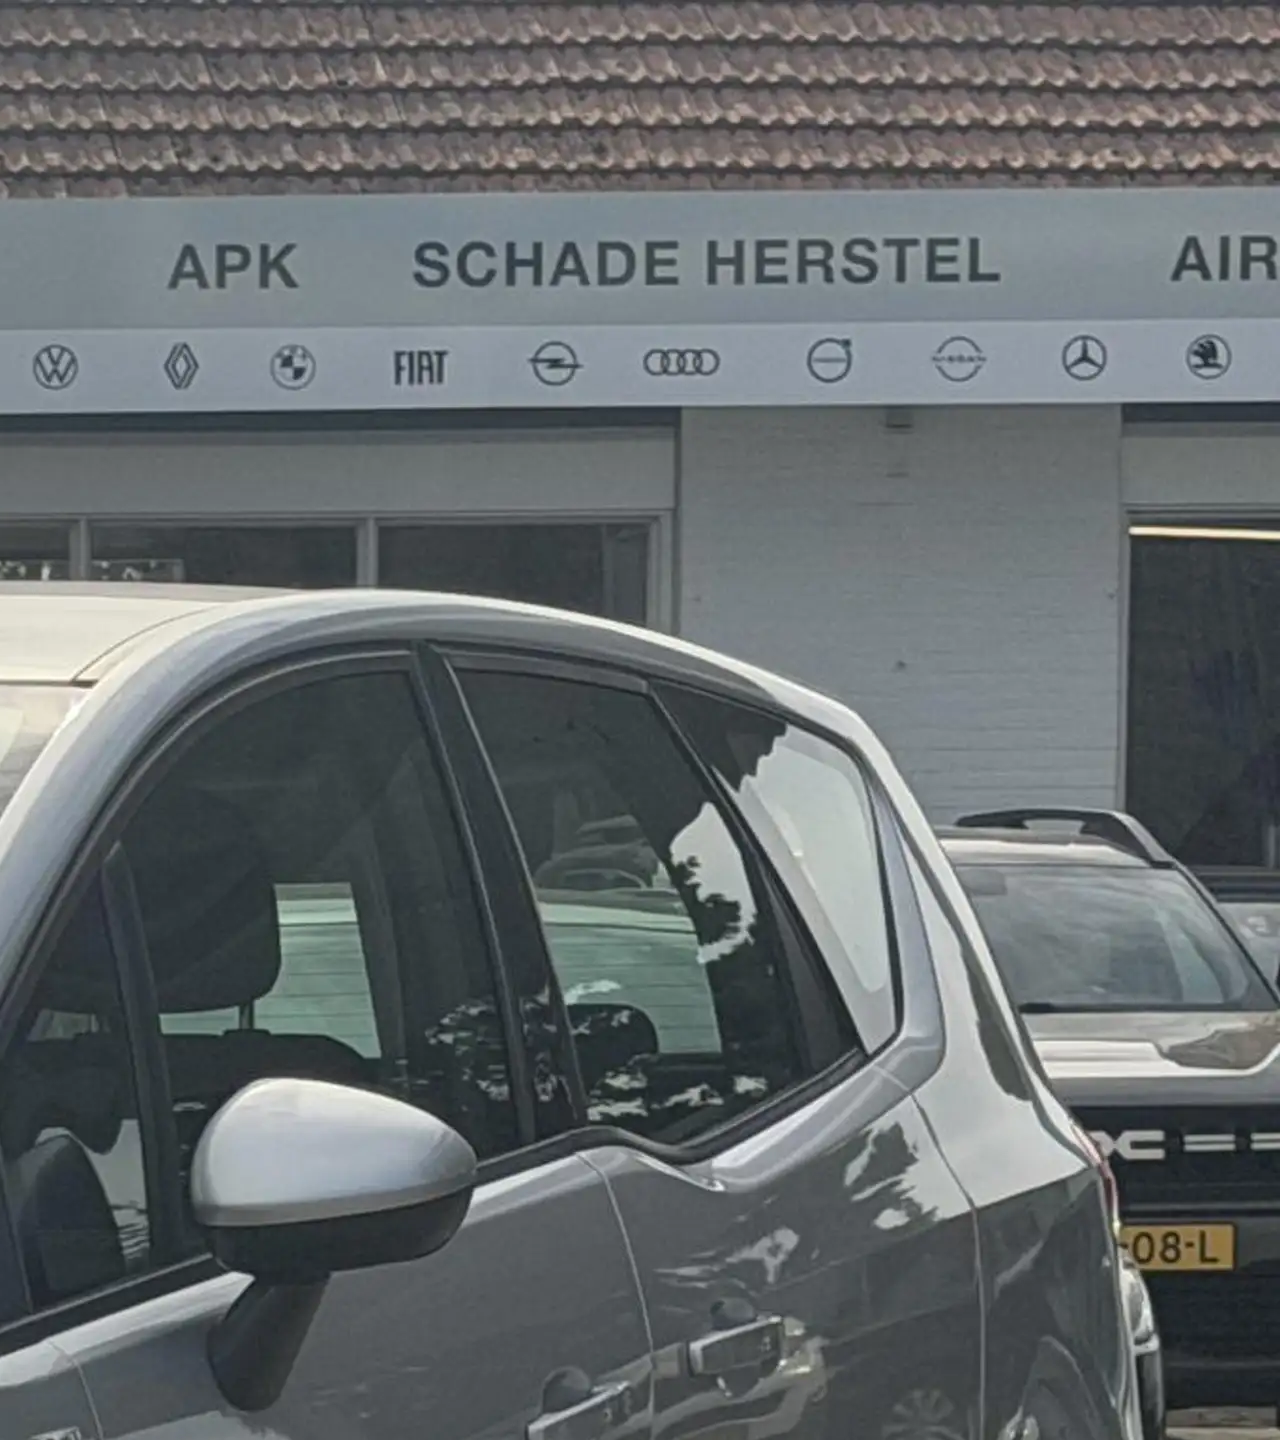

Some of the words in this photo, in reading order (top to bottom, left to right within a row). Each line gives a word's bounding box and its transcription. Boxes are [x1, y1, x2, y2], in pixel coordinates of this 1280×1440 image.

[168, 244, 298, 289] APK
[413, 241, 678, 287] SCHADE
[707, 238, 1000, 285] HERSTEL
[1171, 236, 1278, 281] AIR
[394, 350, 448, 385] FIAT
